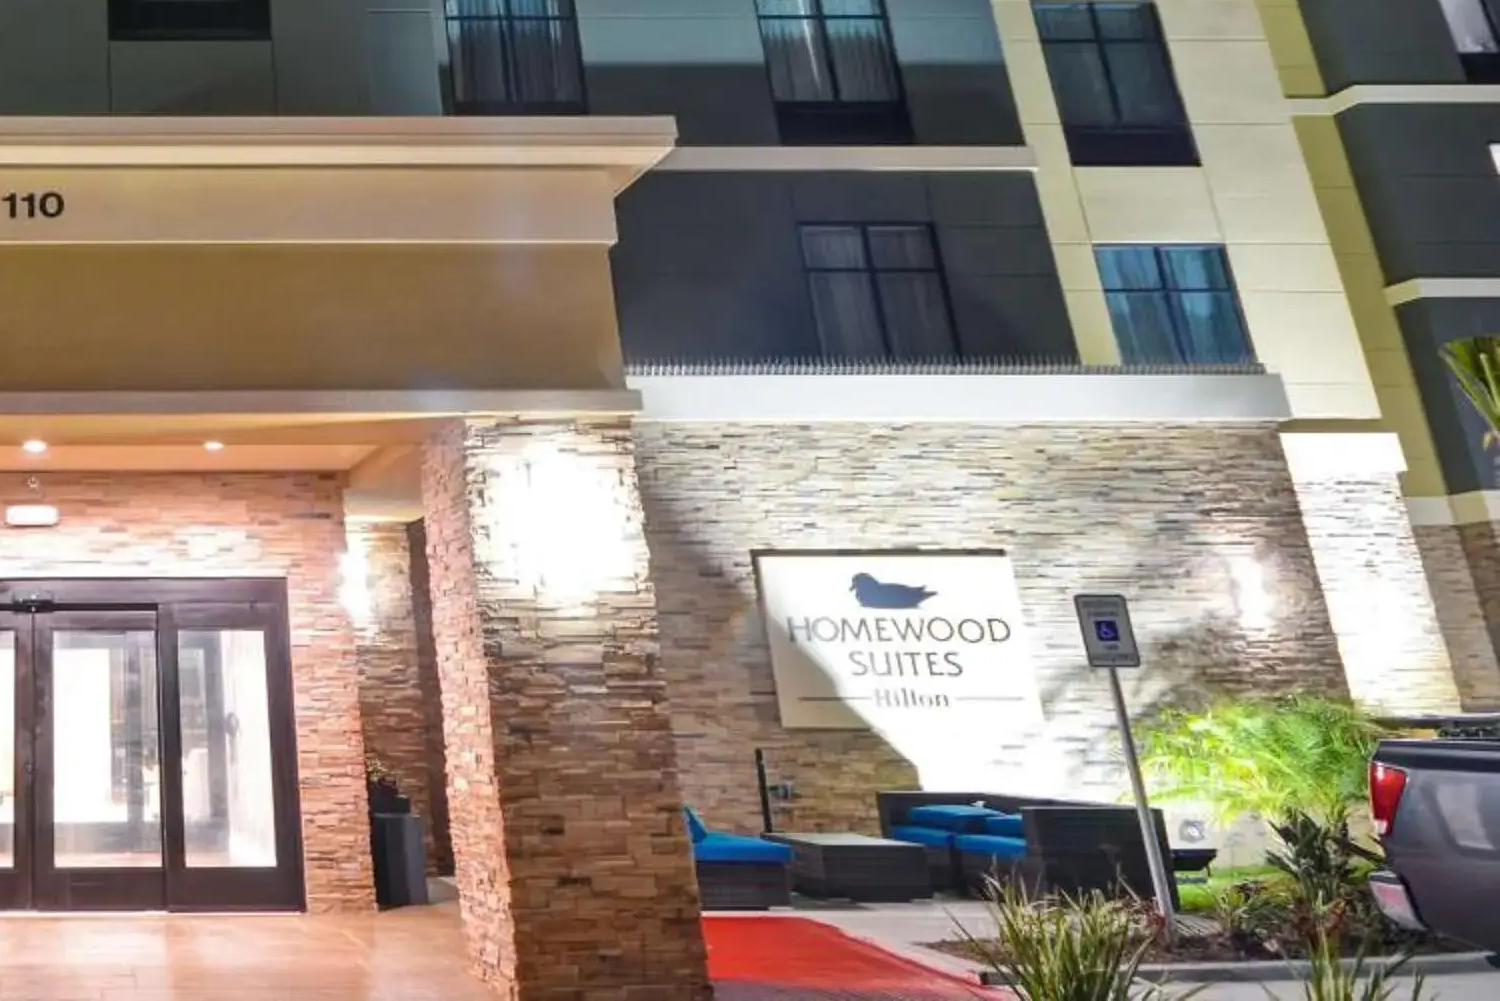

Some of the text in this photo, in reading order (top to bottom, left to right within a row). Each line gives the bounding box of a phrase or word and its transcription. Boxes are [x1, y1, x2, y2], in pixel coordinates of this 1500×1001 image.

[1, 192, 64, 218] 110
[786, 616, 1011, 644] HOMEWOOD
[849, 651, 963, 677] SUITES
